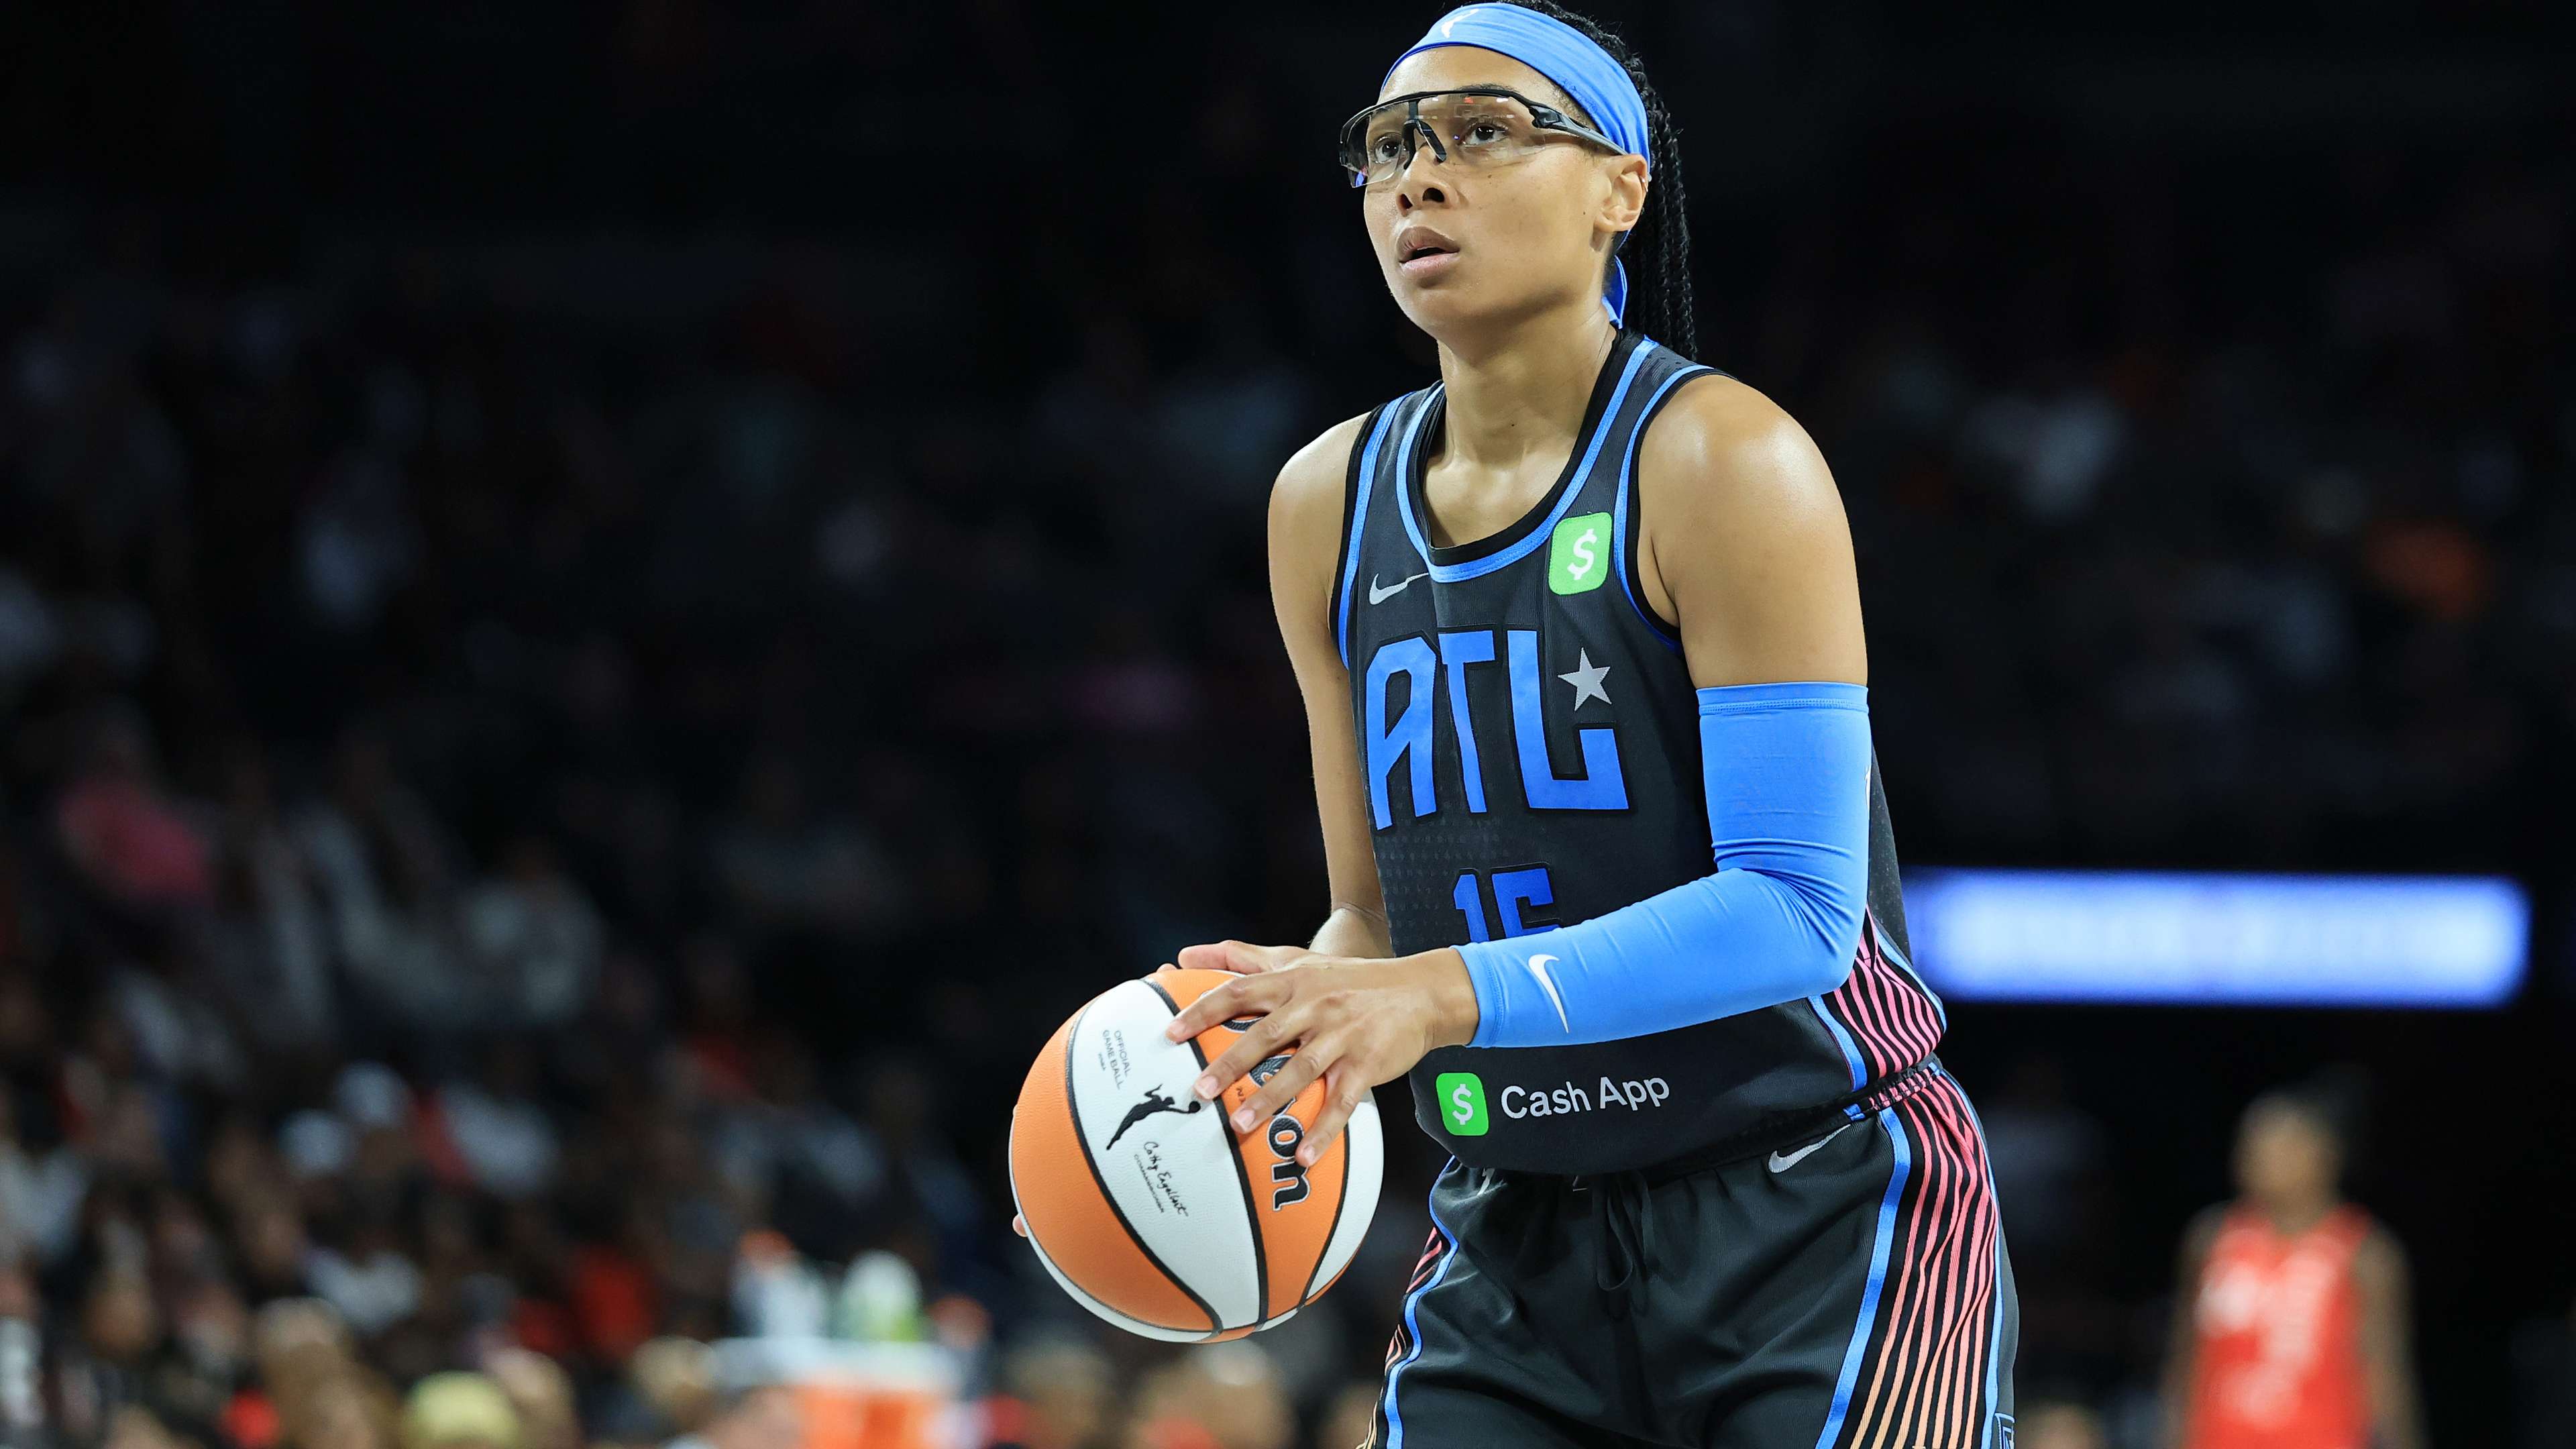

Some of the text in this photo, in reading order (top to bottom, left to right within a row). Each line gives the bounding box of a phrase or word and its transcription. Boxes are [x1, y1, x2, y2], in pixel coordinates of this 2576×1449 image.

[1366, 629, 1629, 830] ATL
[1102, 1030, 1124, 1089] GAME BALL
[1114, 1030, 1131, 1077] OFFICIAL
[1501, 1081, 1592, 1119] Cash
[1599, 1076, 1670, 1111] App
